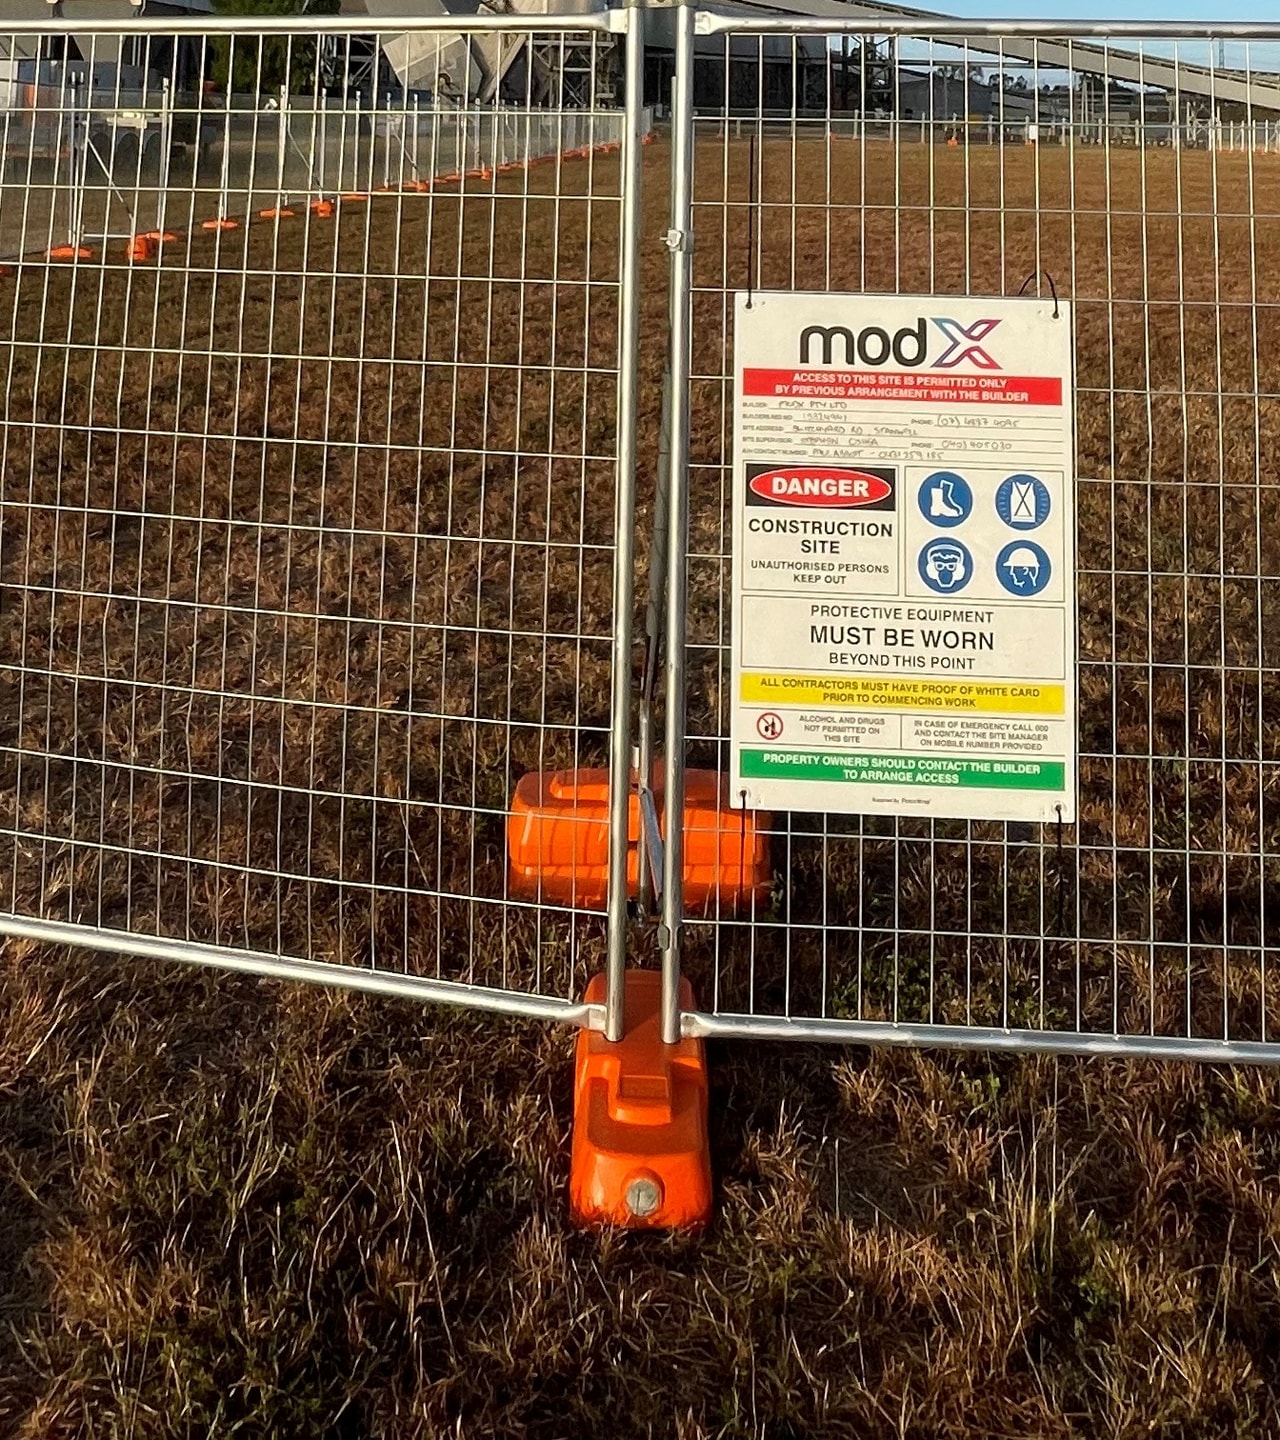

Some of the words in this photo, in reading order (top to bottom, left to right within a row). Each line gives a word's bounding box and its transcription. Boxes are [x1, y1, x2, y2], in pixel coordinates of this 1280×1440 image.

[793, 373, 836, 383] ACCESS
[837, 374, 851, 383] TO
[853, 374, 876, 384] THIS
[878, 375, 902, 385] SITE
[903, 376, 915, 385] IS
[916, 377, 977, 387] PERMITTED
[979, 378, 1007, 388] ONLY
[775, 384, 790, 394] BY
[792, 385, 845, 396] PREVIOUS
[847, 388, 929, 398] ARRANGEMENT
[930, 390, 957, 399] WITH
[958, 391, 980, 400] THE
[982, 392, 1029, 401] BUILDER
[772, 477, 869, 497] DANGER
[748, 518, 893, 537] CONSTRUCTION
[801, 539, 840, 554] SITE
[751, 560, 835, 572] UNAUTHORISED
[838, 563, 889, 574] PERSONS
[793, 574, 821, 583] KEEP
[824, 575, 847, 584] OUT
[810, 605, 903, 620] PROTECTIVE
[907, 609, 994, 623] EQUIPMENT
[810, 626, 876, 645] MUST
[884, 628, 915, 647] BE
[921, 630, 994, 650] WORN
[829, 652, 890, 667] BEYOND
[892, 655, 926, 668] THIS
[931, 657, 976, 670] POINT
[760, 678, 779, 687] ALL
[782, 678, 859, 690] CONTRACTORS
[861, 682, 889, 691] MUST
[891, 683, 919, 693] HAVE
[921, 684, 957, 694] PROOF
[959, 685, 974, 695] OF
[976, 686, 1008, 696] WHITE
[1010, 688, 1040, 697] CARD
[823, 692, 854, 702] PRIOR
[856, 693, 870, 703] TO
[872, 694, 942, 706] COMMENCING
[944, 697, 977, 707] WORK
[799, 715, 837, 723] ALCOHOL
[839, 716, 856, 724] AND
[857, 717, 885, 725] DRUGS
[924, 720, 946, 728] CASE
[960, 722, 1010, 730] EMERGENCY
[1012, 723, 1033, 731] CALL
[804, 724, 820, 732] NOT
[822, 725, 866, 734] PERMITTED
[914, 729, 931, 737] AND
[933, 730, 970, 738] CONTACT
[972, 731, 986, 739] THE
[989, 732, 1006, 740] SITE
[1008, 733, 1048, 741] MANAGER
[824, 734, 841, 742] THIS
[842, 735, 860, 743] SITE
[920, 738, 932, 746] ON
[934, 739, 964, 748] MOBILE
[966, 741, 1000, 749] NUMBER
[1002, 742, 1042, 750] PROVIDED
[763, 753, 820, 765] PROPERTY
[822, 756, 869, 767] OWNERS
[871, 757, 916, 769] SHOULD
[918, 760, 969, 771] CONTACT
[970, 762, 991, 772] THE
[993, 763, 1040, 774] BUILDER
[843, 769, 858, 779] TO
[860, 770, 914, 782] ARRANGE
[916, 772, 960, 784] ACCESS
